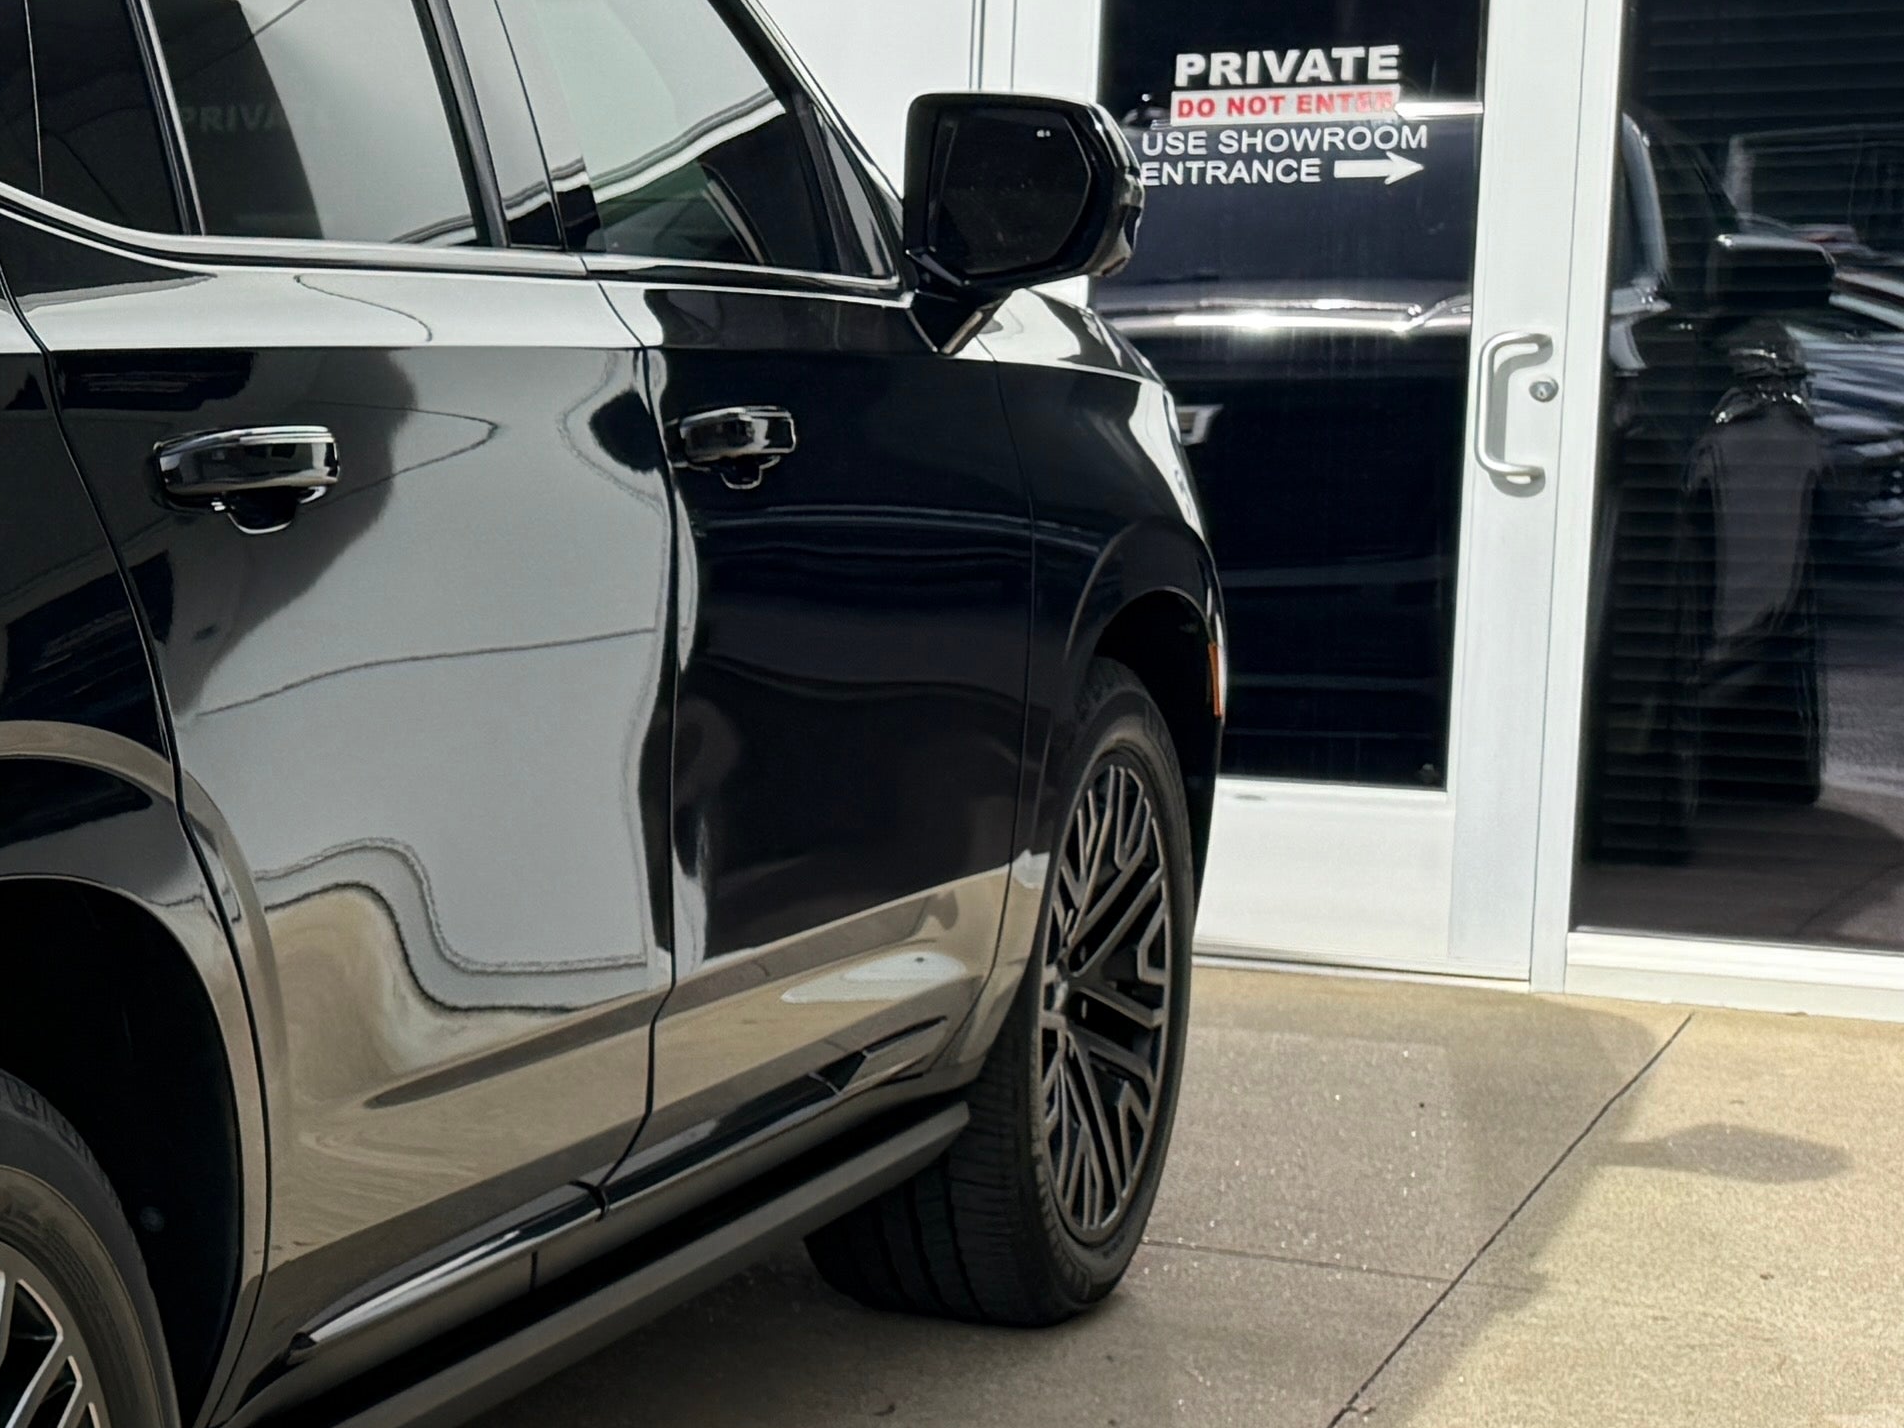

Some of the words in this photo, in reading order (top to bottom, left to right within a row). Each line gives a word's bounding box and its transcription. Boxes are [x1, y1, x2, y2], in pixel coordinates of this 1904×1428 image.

[1174, 44, 1401, 87] PRIVATE
[1177, 97, 1216, 119] DO
[1227, 94, 1286, 116] NOT
[1295, 89, 1395, 115] ENTER
[1141, 130, 1208, 157] USE
[1217, 124, 1429, 155] SHOWROOM
[1141, 157, 1322, 187] ENTRANCE
